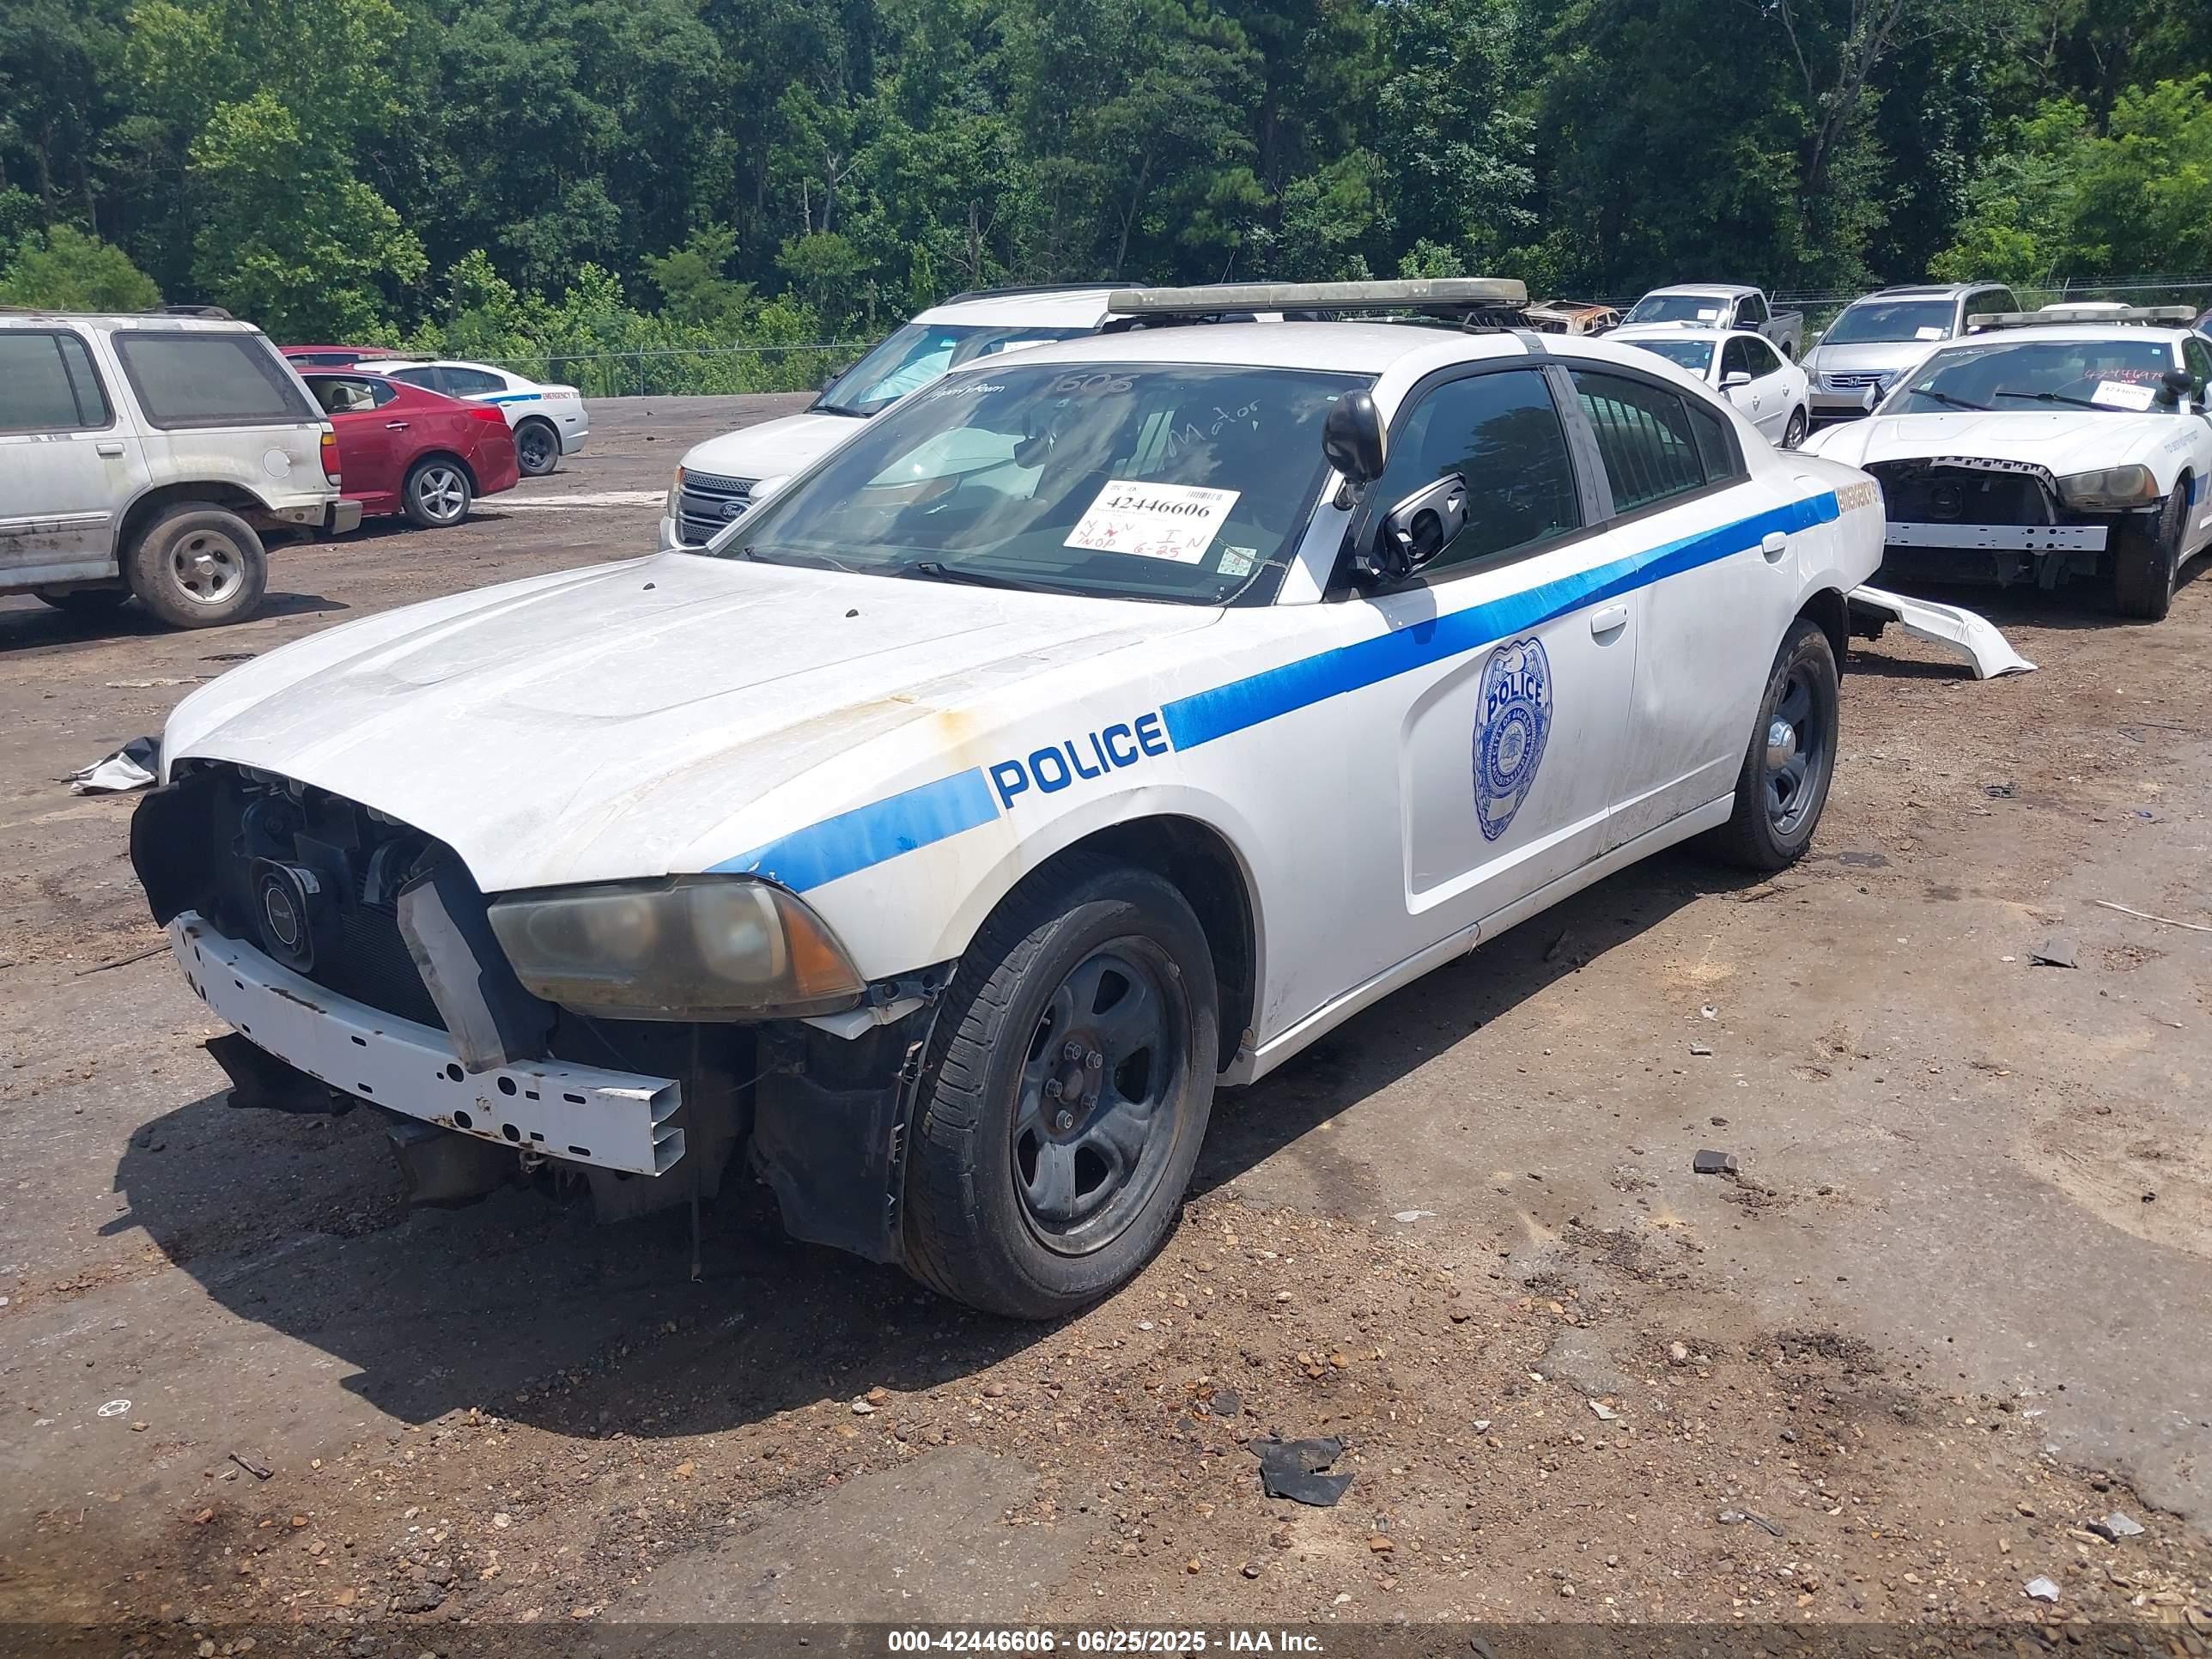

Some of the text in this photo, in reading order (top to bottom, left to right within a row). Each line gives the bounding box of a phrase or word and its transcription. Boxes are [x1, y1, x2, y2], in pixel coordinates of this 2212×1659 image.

[1169, 399, 1262, 458] Motor
[1107, 496, 1215, 518] 42446606
[1486, 672, 1543, 724] POLICE
[1503, 714, 1511, 726] OF
[988, 712, 1169, 810] POLICE
